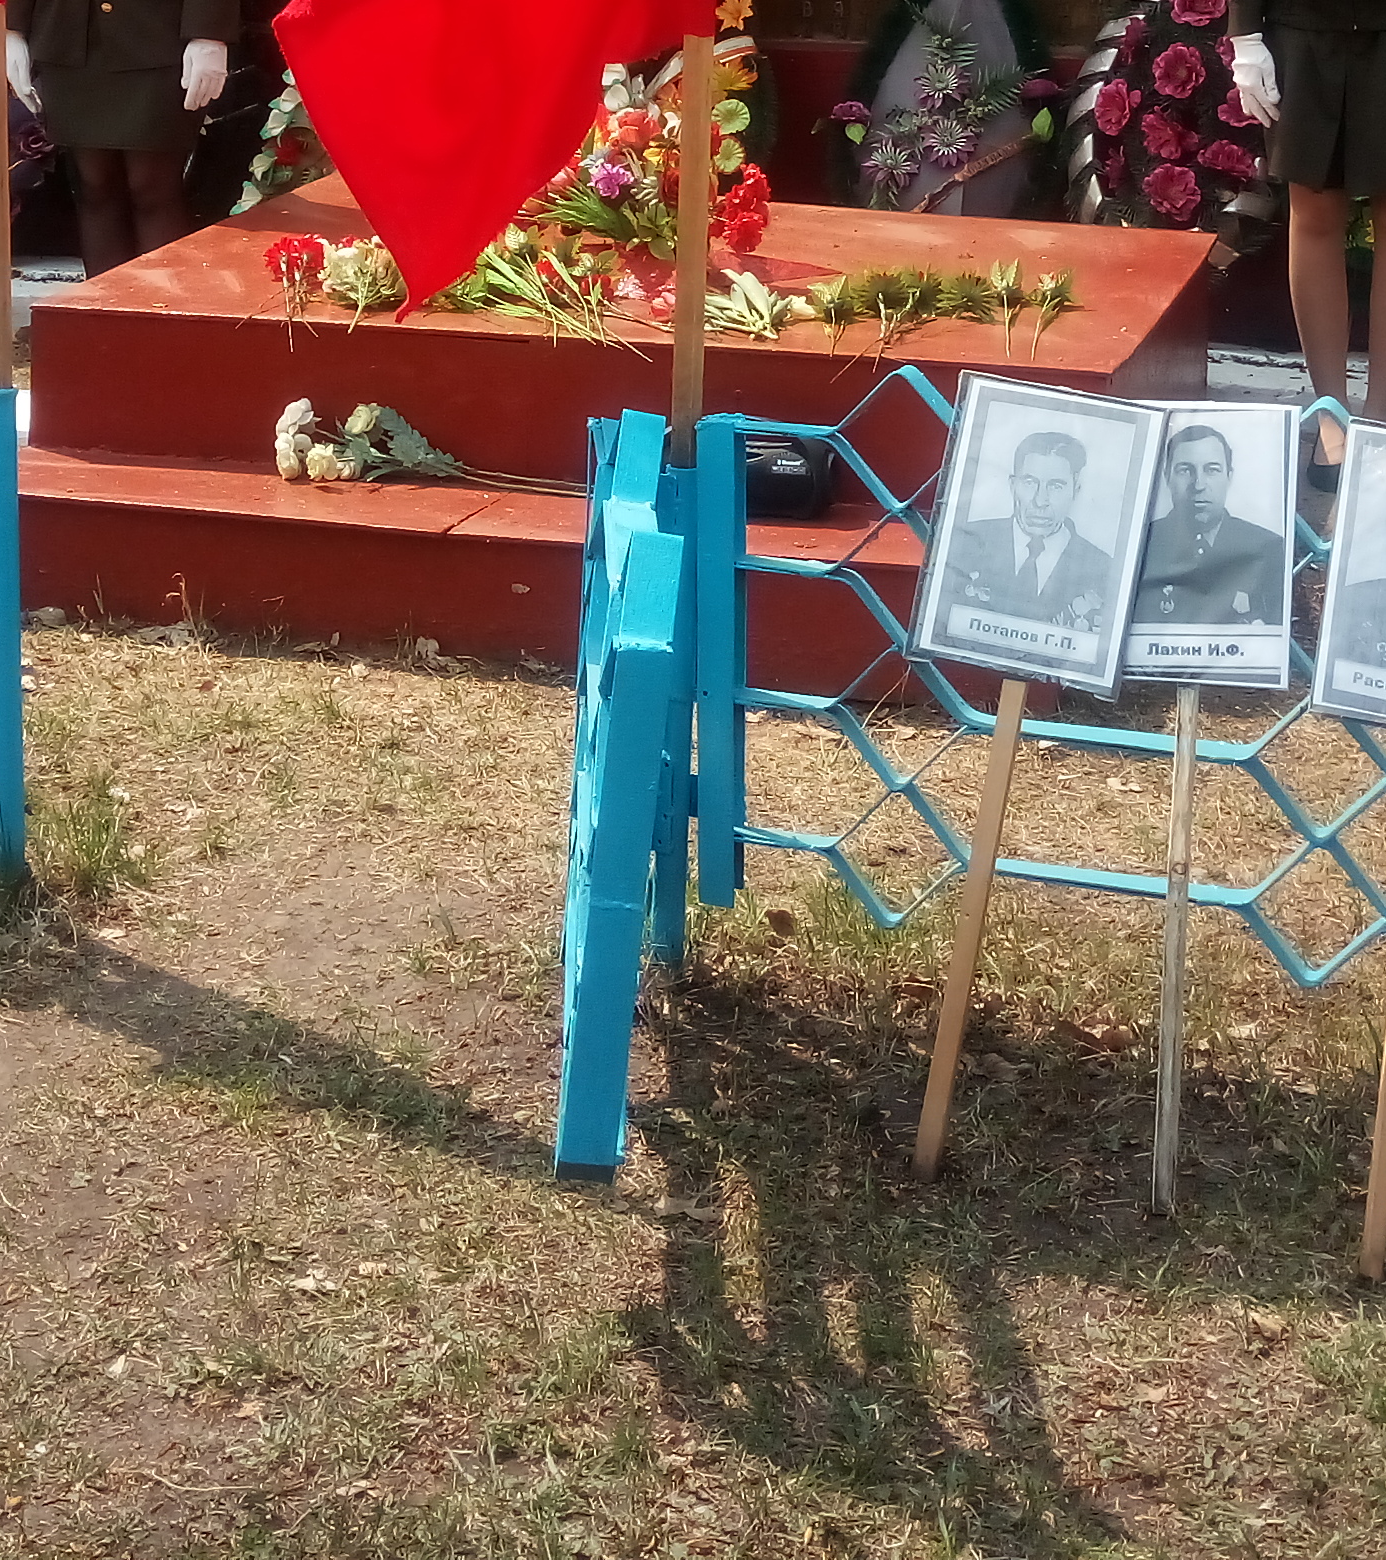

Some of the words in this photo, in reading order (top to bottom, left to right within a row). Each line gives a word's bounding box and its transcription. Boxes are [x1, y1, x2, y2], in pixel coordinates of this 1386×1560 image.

[969, 617, 1039, 643] Потапов
[1044, 633, 1078, 651] Г.П.
[1147, 642, 1203, 657] Лахин
[1207, 642, 1245, 657] И.Ф.
